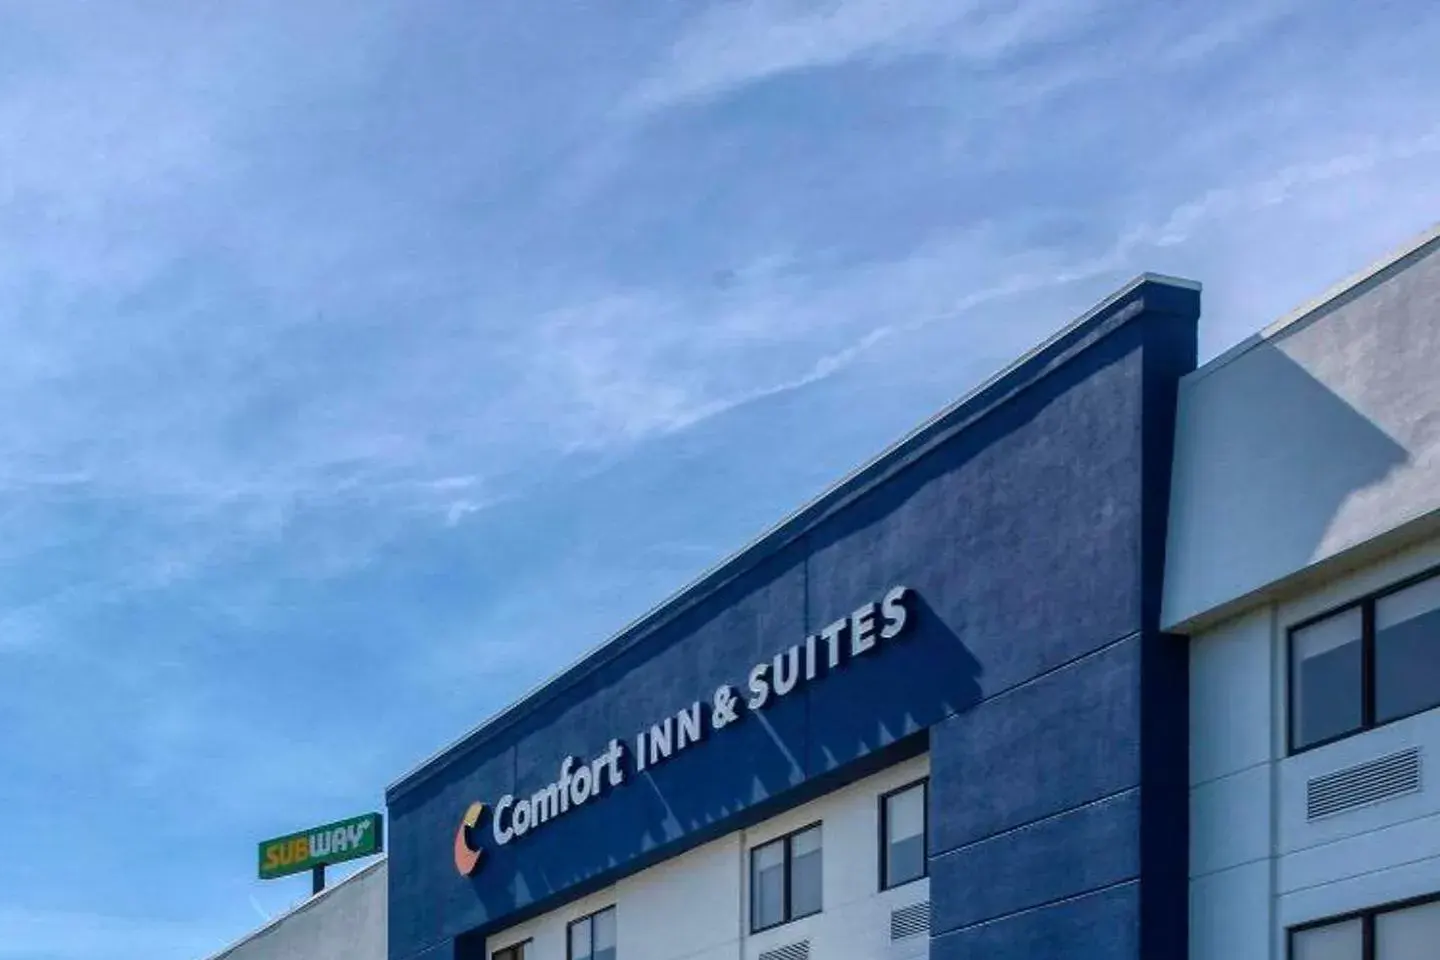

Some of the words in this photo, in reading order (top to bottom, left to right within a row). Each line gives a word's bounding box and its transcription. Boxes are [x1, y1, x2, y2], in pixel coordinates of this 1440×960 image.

[493, 739, 623, 846] Comfort
[637, 701, 701, 772] INN
[712, 684, 739, 729] &
[748, 585, 907, 710] SUITES
[264, 820, 371, 868] SUBWAY
